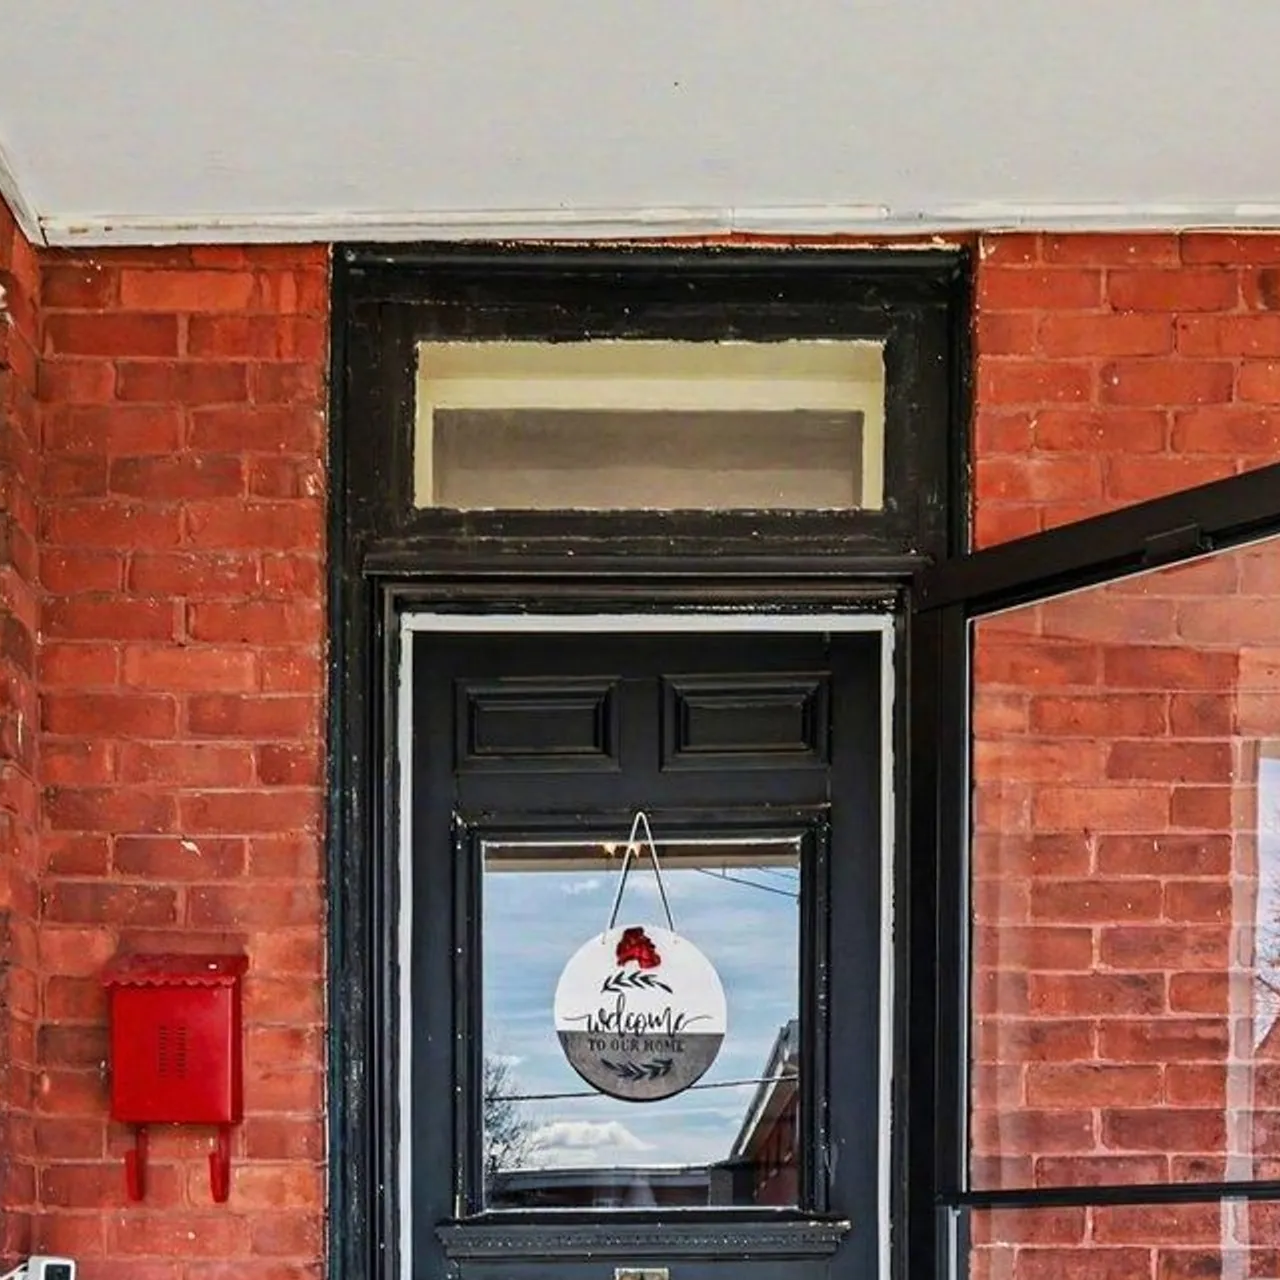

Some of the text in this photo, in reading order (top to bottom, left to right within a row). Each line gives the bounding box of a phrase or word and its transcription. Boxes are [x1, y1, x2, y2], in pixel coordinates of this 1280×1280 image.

[563, 993, 713, 1037] welcome
[589, 1038, 686, 1053] TO OUR HOME
